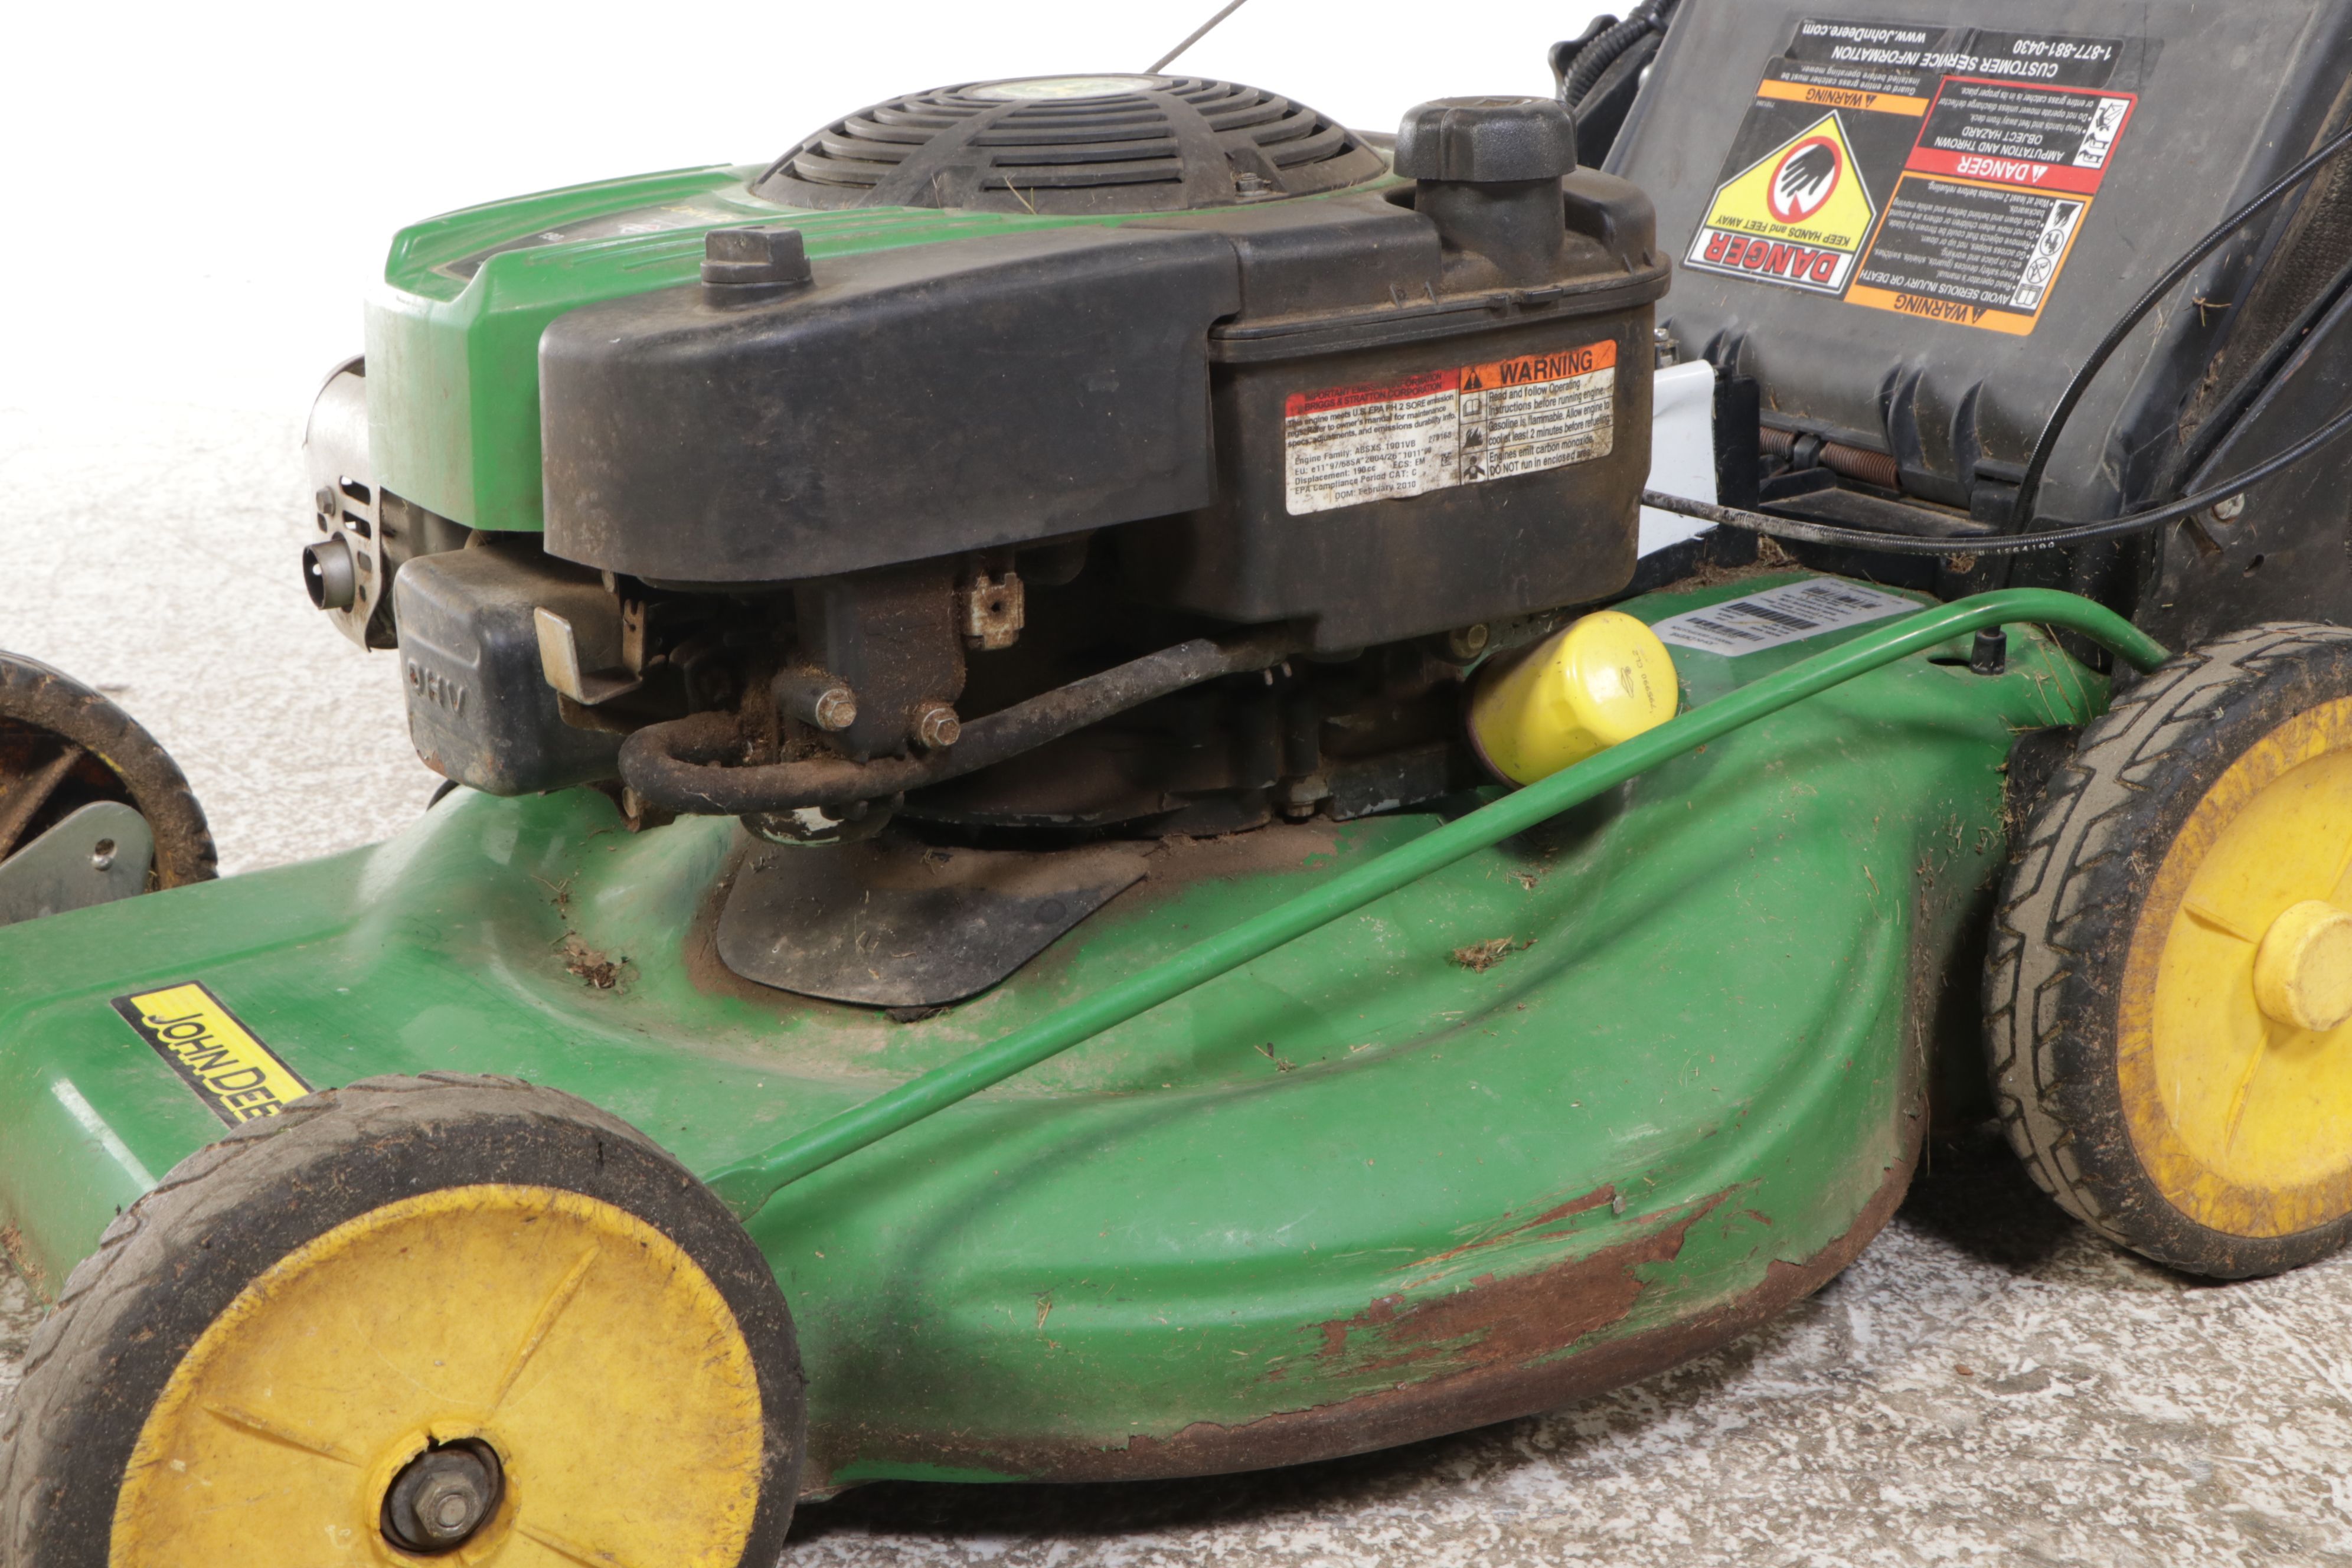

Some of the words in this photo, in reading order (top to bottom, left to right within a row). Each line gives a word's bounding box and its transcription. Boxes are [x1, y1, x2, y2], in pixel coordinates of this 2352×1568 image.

[1801, 23, 1928, 43] www.JohnDeere.com
[1830, 45, 1921, 65] INFORMATION
[2011, 39, 2114, 60] 1-877-881-0430
[1919, 51, 1981, 70] SERVICE
[1826, 66, 1861, 76] operating
[1977, 57, 2060, 78] CUSTOMER
[1837, 78, 1860, 86] grass
[1862, 72, 1887, 81] before
[1886, 74, 1920, 84] installed
[1891, 85, 1916, 94] Guard
[1961, 87, 1979, 96] place.
[1978, 88, 2001, 97] proper
[1804, 88, 1864, 106] WARNING
[1938, 97, 1967, 108] deflector
[2023, 93, 2047, 102] catcher
[1966, 99, 1998, 112] discharge
[1997, 104, 2019, 113] unless
[2018, 106, 2041, 114] mower
[2041, 108, 2066, 116] operate
[2077, 112, 2089, 121] Do
[1969, 114, 1986, 123] deck.
[1986, 116, 2002, 125] from
[2001, 116, 2018, 125] away
[2017, 119, 2031, 128] feet
[2044, 122, 2065, 131] hands
[2064, 122, 2083, 133] Keep
[1961, 126, 2003, 139] HAZARD
[2003, 131, 2044, 144] OBJECT
[1933, 136, 1978, 151] THROWN
[1977, 142, 2000, 153] AND
[1999, 144, 2064, 161] AMPUTATION
[1955, 156, 2030, 181] DANGER
[1928, 181, 1956, 193] refueling.
[1956, 187, 1978, 197] before
[1978, 190, 2004, 200] minutes
[2009, 194, 2026, 204] least
[1892, 197, 1916, 207] moving
[1916, 202, 1933, 211] while
[2033, 198, 2050, 207] Wait
[1946, 207, 1968, 217] before
[1966, 210, 1991, 220] behind
[2010, 205, 2046, 217] backwards.
[1714, 214, 1743, 227] AWAY
[1923, 214, 1943, 222] others
[1952, 218, 1978, 228] children
[2004, 215, 2023, 225] down
[2022, 218, 2041, 227] Look
[1743, 219, 1768, 231] FEET
[1768, 223, 1788, 233] and
[1915, 224, 1938, 233] thrown
[1978, 222, 1997, 231] when
[1786, 227, 1822, 241] HANDS
[1822, 233, 1851, 246] KEEP
[1965, 231, 1979, 240] that
[1979, 233, 2004, 243] objects
[2004, 237, 2031, 248] Remove
[1941, 247, 1968, 258] working.
[1992, 247, 2016, 255] across
[2015, 250, 2026, 259] Go
[1700, 231, 1841, 284] DANGER
[1980, 256, 2000, 264] place
[1954, 262, 1979, 273] devices
[1979, 265, 1999, 275] safety
[1858, 269, 1890, 283] DEATH
[1889, 274, 1905, 285] OR
[1936, 270, 1961, 279] manual.
[1961, 274, 1994, 285] operator's
[1999, 269, 2017, 280] Keep
[1903, 277, 1938, 292] INJURY
[1994, 280, 2013, 290] Read
[1937, 283, 1981, 299] SERIOUS
[1979, 290, 2010, 305] AVOID
[1892, 293, 1969, 322] WARNING
[1500, 349, 1592, 386] WARNING
[1489, 390, 1506, 402] Read
[1509, 388, 1521, 398] and
[1525, 386, 1547, 396] follow
[1549, 380, 1580, 393] Operating
[1305, 398, 1335, 410] BRIGGS
[1344, 391, 1385, 404] STRATTON
[1489, 401, 1531, 416] Instructions
[1534, 396, 1556, 409] before
[1558, 393, 1581, 404] running
[1305, 415, 1328, 425] engine
[1330, 411, 1350, 420] meets
[1369, 404, 1383, 414] EPA
[1406, 399, 1425, 410] SORE
[1427, 395, 1453, 405] emission
[1337, 419, 1363, 429] owner's
[1365, 413, 1391, 424] manual
[1407, 407, 1446, 419] maintenance
[1488, 419, 1518, 432] Gasoline
[1528, 411, 1564, 425] flammable.
[1566, 409, 1582, 419] Allow
[1583, 403, 1602, 414] engine
[1358, 426, 1371, 435] and
[1374, 423, 1412, 434] emissions
[1415, 416, 1440, 426] durability
[1443, 412, 1455, 420] info.
[1488, 433, 1502, 445] cool
[1512, 430, 1528, 441] least
[1530, 429, 1534, 438] 2
[1536, 426, 1562, 437] minutes
[1564, 422, 1583, 432] before
[1295, 455, 1321, 465] Engine
[1324, 449, 1351, 460] Family:
[1489, 450, 1516, 462] Engines
[1519, 445, 1534, 456] emit
[1536, 442, 1559, 453] carbon
[1393, 459, 1412, 469] ECS:
[1415, 457, 1425, 465] EM
[1490, 464, 1501, 475] DO
[1503, 461, 1519, 473] NOT
[1521, 460, 1533, 469] run
[1543, 450, 1574, 465] enclosed
[1295, 469, 1349, 485] Displacement:
[1354, 466, 1375, 474] 190cc
[1295, 485, 1309, 494] EPA
[1314, 479, 1357, 491] Compliance
[1361, 472, 1385, 483] Period
[1389, 469, 1408, 479] CAT:
[1335, 489, 1355, 499] DOM:
[1397, 480, 1416, 490] 2010
[407, 656, 468, 717] OHV
[148, 1013, 239, 1072] JOHN
[208, 1066, 283, 1118] DEE
